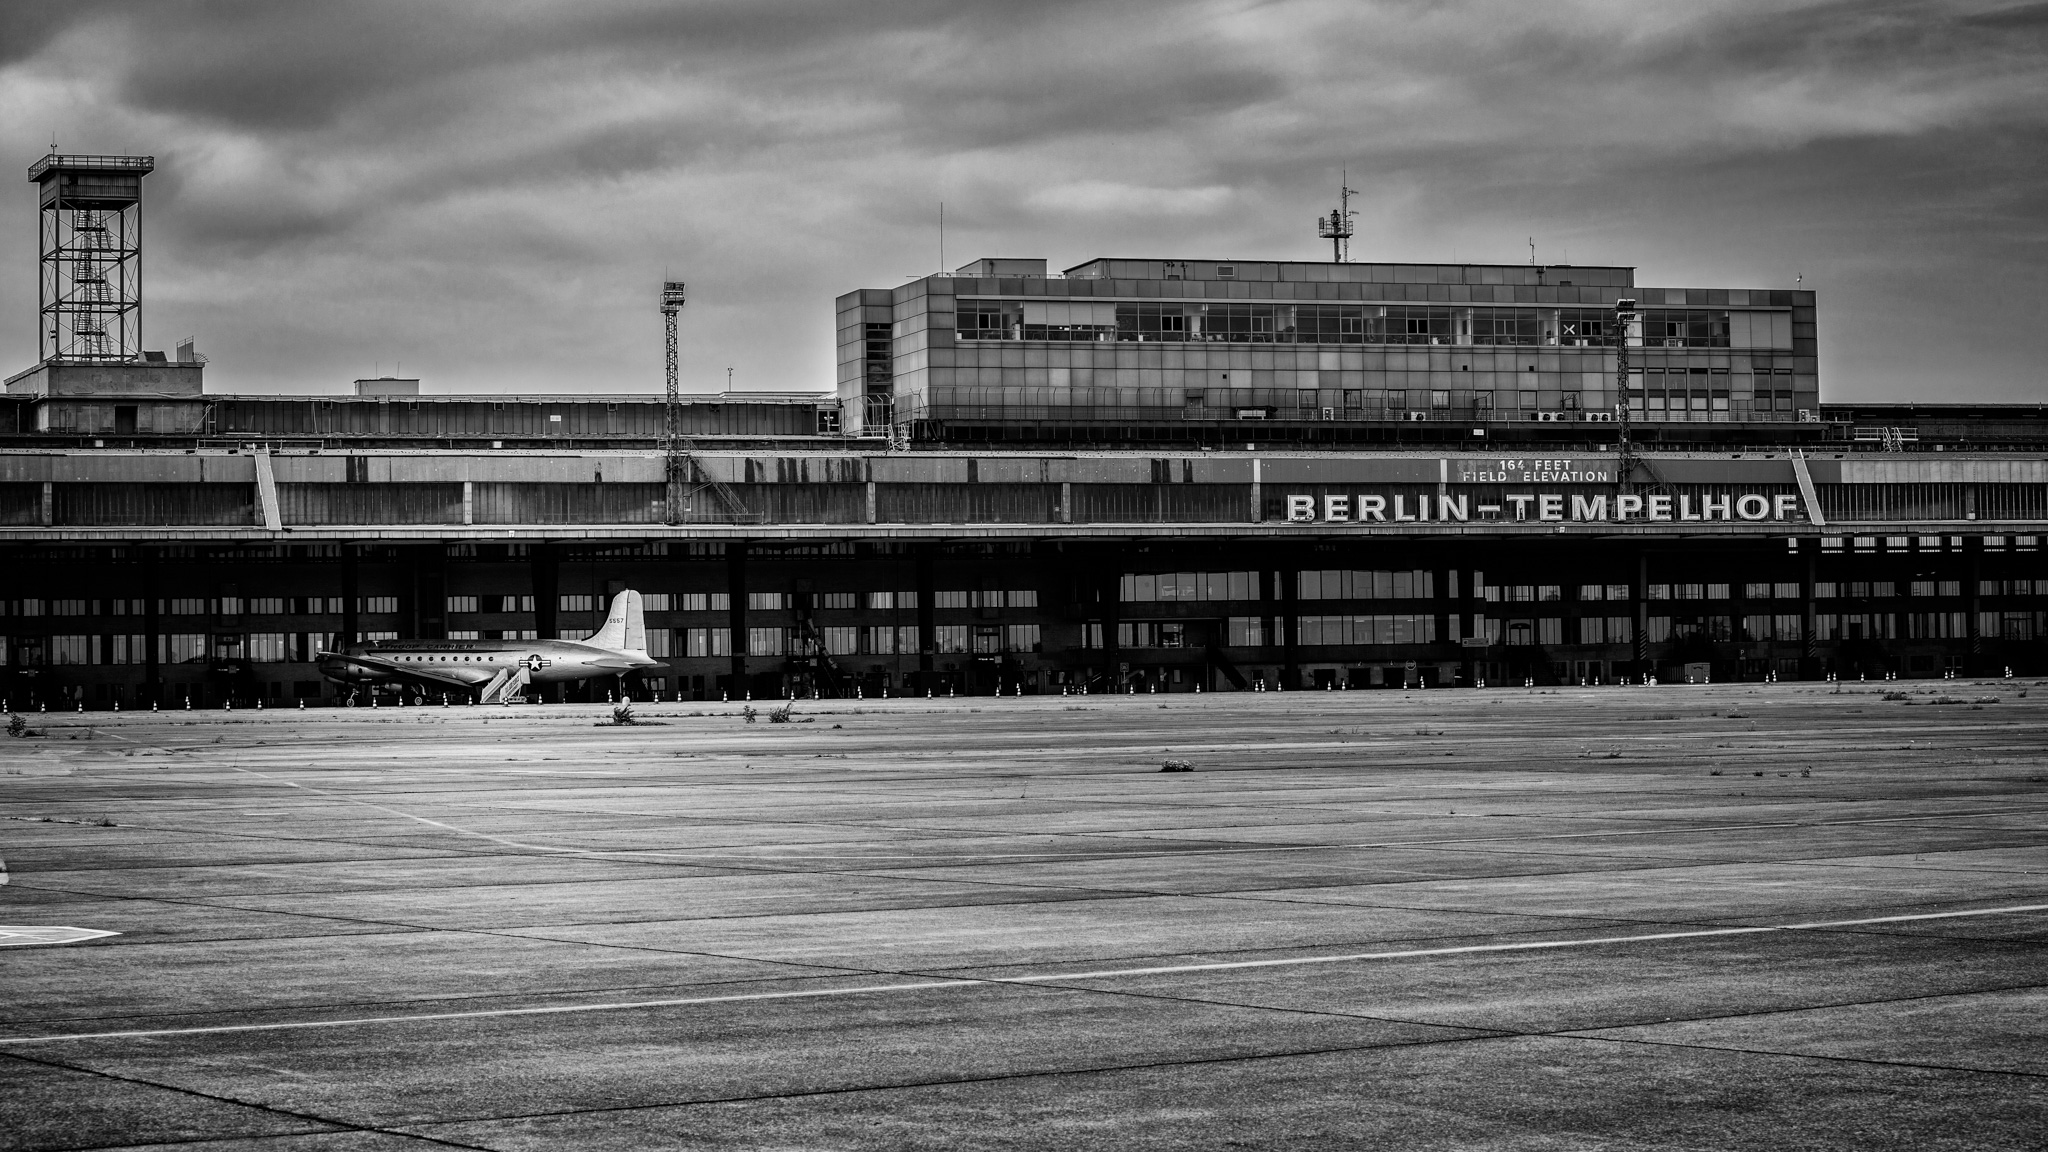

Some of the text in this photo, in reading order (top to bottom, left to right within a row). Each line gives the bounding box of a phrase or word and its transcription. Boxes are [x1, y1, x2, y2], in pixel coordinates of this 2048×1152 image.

[1500, 460, 1571, 471] 164 FEET
[1463, 471, 1608, 482] FIELD ELEVATION
[1287, 494, 1797, 522] BERLIN-TEMPELHOF
